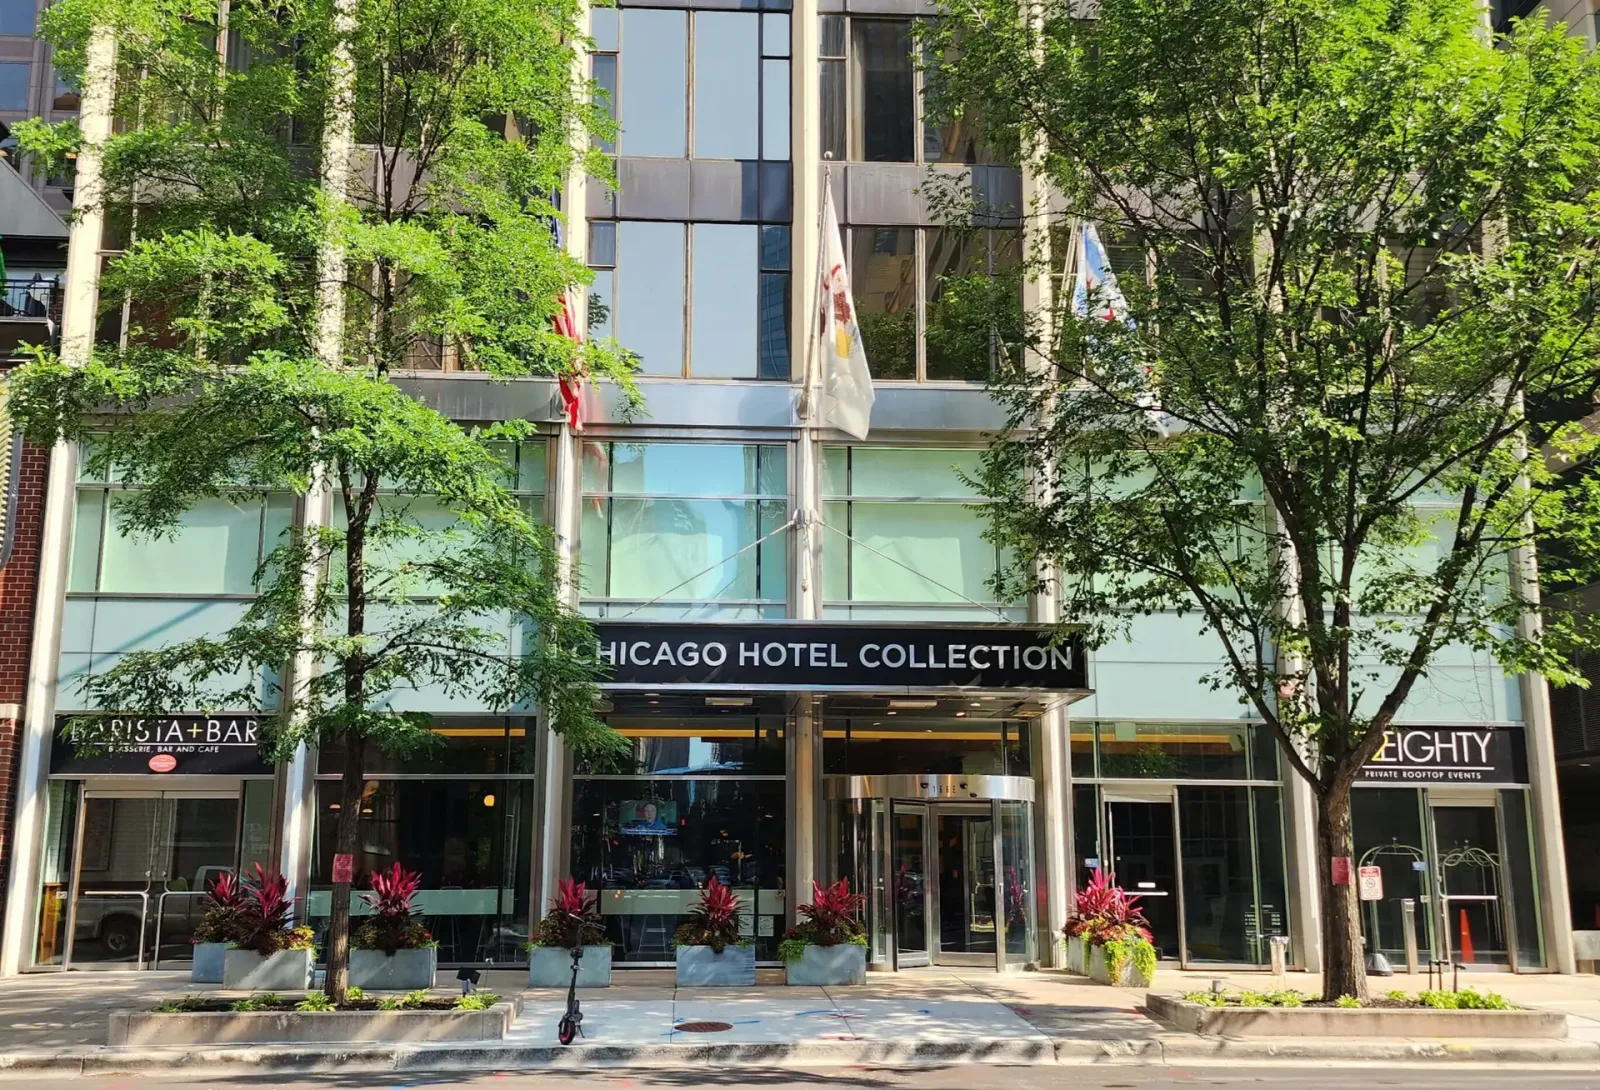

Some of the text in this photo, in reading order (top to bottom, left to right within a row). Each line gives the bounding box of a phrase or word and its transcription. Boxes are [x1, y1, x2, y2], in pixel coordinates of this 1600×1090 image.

[739, 642, 848, 668] HOTEL
[859, 643, 1073, 671] COLLECTION
[108, 745, 155, 754] BASSERIE,
[157, 745, 173, 753] BAR
[1365, 770, 1482, 780] PRIVATE ROOFTOP EVENTS
